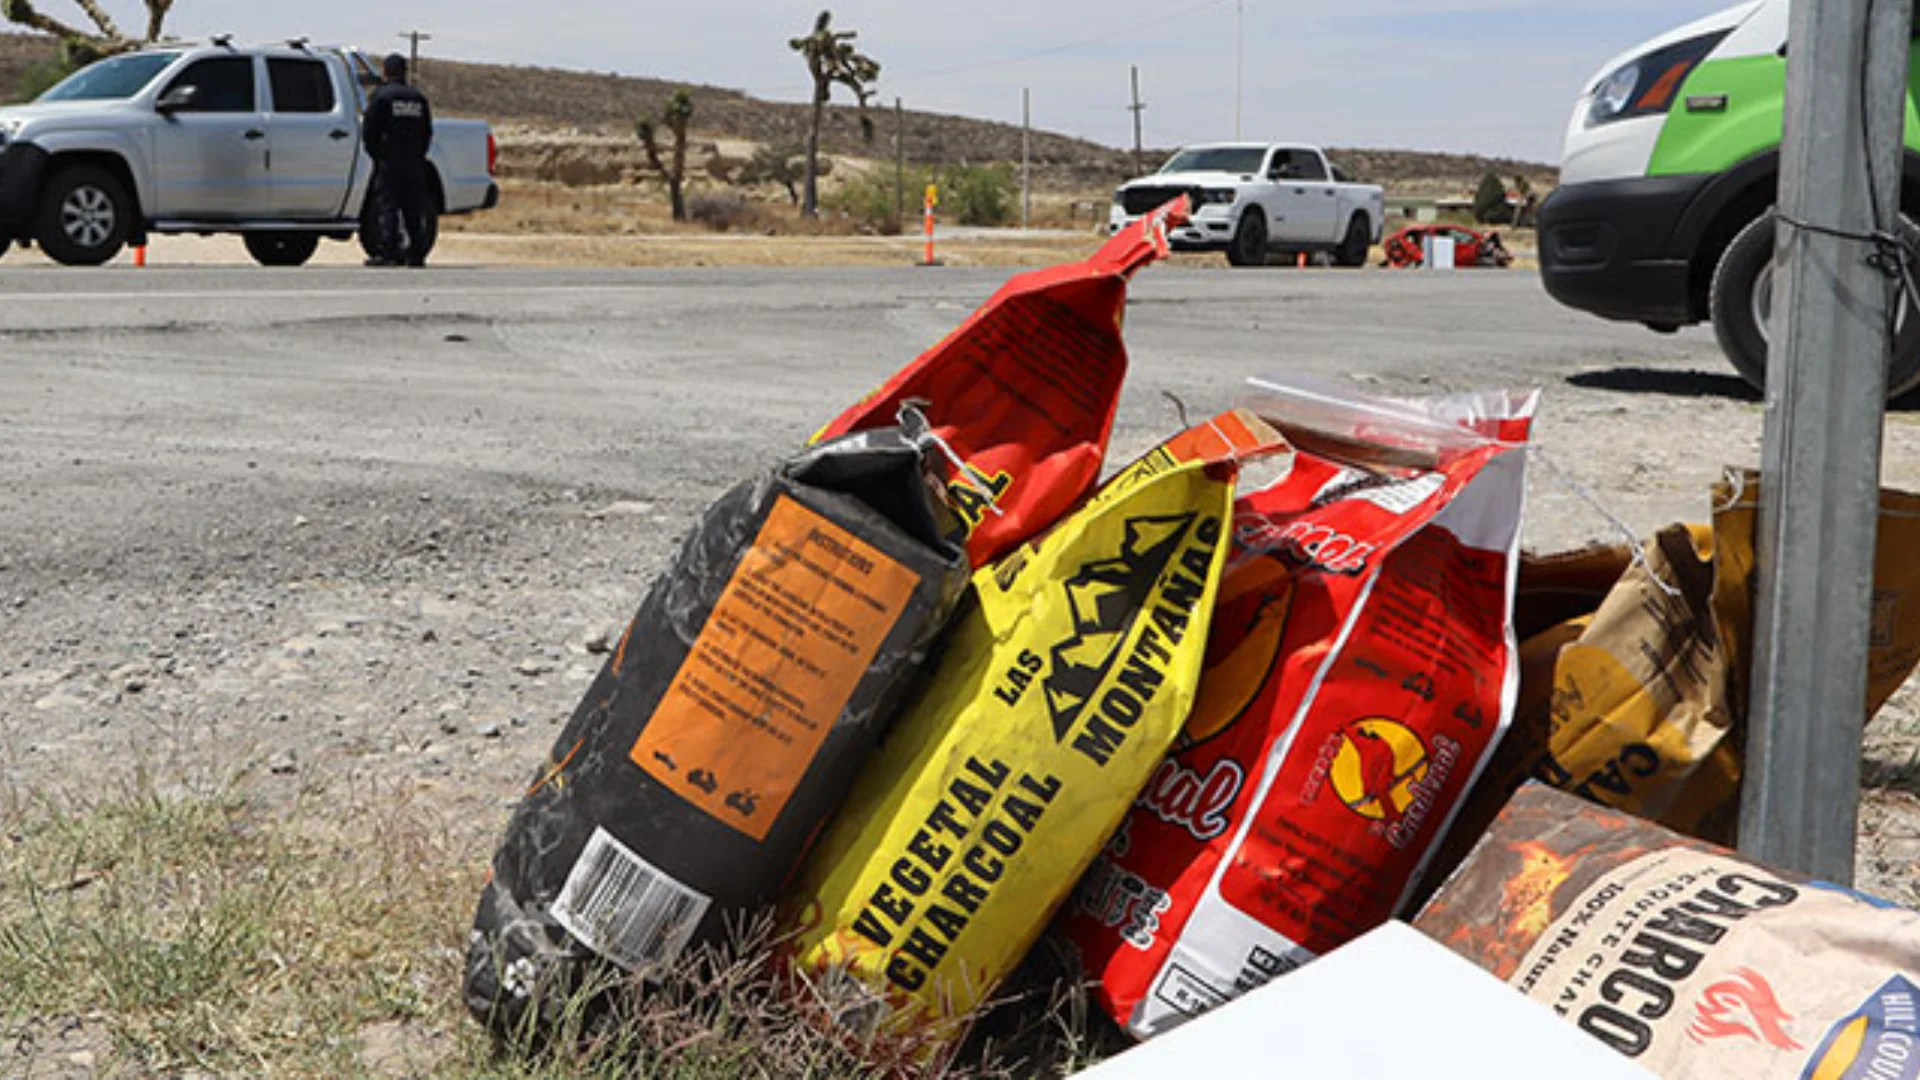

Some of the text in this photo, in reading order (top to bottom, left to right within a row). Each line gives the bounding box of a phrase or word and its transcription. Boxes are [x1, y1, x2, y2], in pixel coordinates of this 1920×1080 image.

[994, 648, 1043, 707] LAS
[1071, 516, 1221, 768] MONTAÑAS
[851, 756, 1011, 949] VEGETAL
[885, 771, 1063, 992] CHARCOAL
[1571, 882, 1626, 927] 100%
[1881, 991, 1917, 1033] HILL
